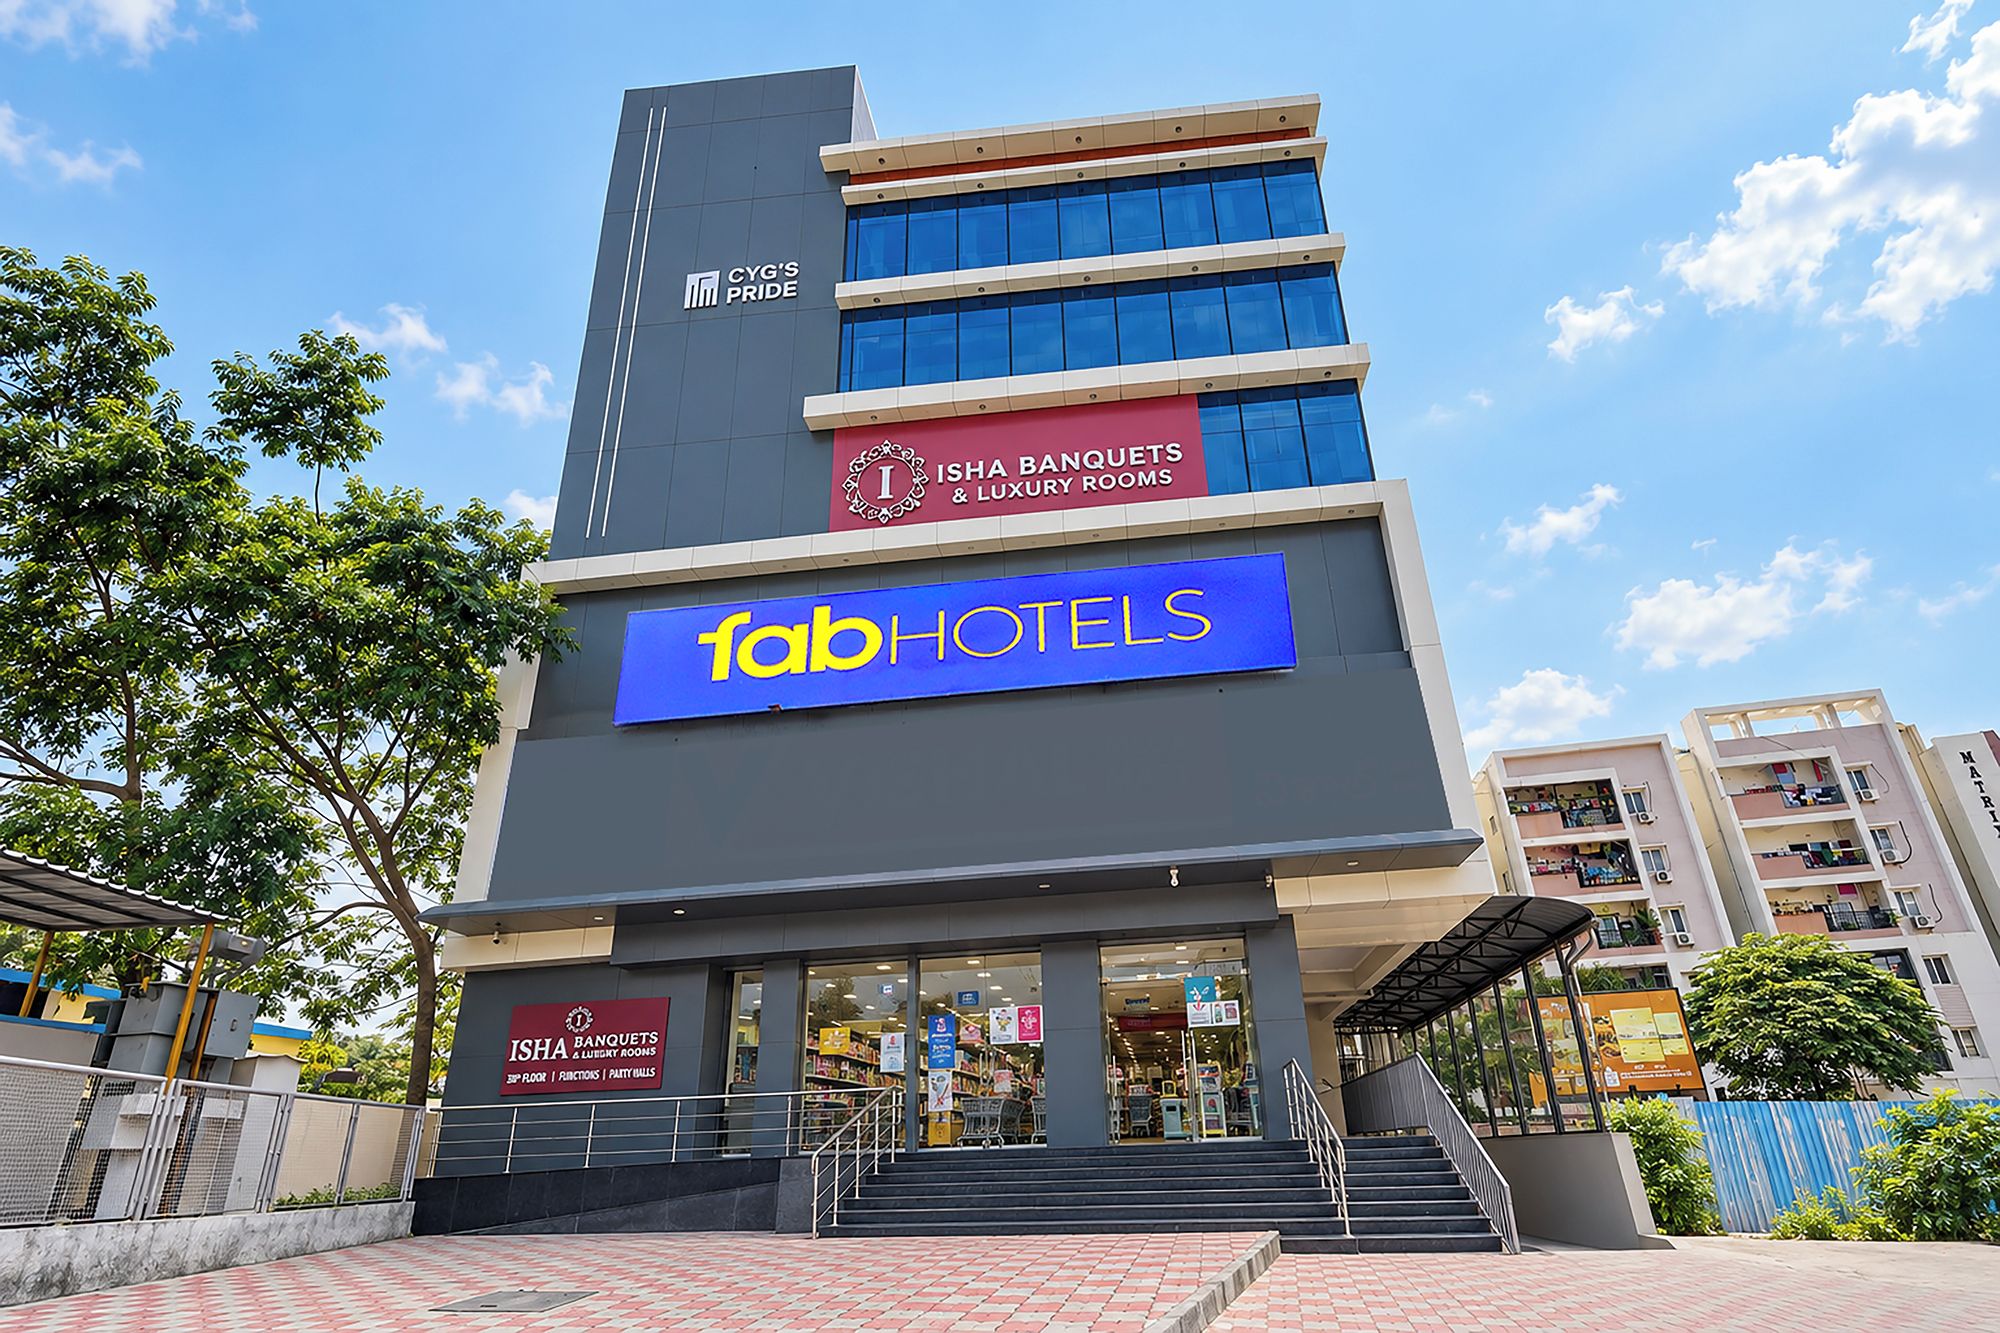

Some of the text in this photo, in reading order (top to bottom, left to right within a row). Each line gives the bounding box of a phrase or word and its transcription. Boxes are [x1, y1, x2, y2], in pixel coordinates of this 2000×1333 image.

[728, 261, 800, 283] CYG'S
[726, 280, 798, 304] PRIDE
[936, 442, 1184, 483] ISHA BANQUETS
[952, 468, 1174, 504] & LUXURY ROOMS
[509, 1031, 659, 1062] ISHA BANQUETS
